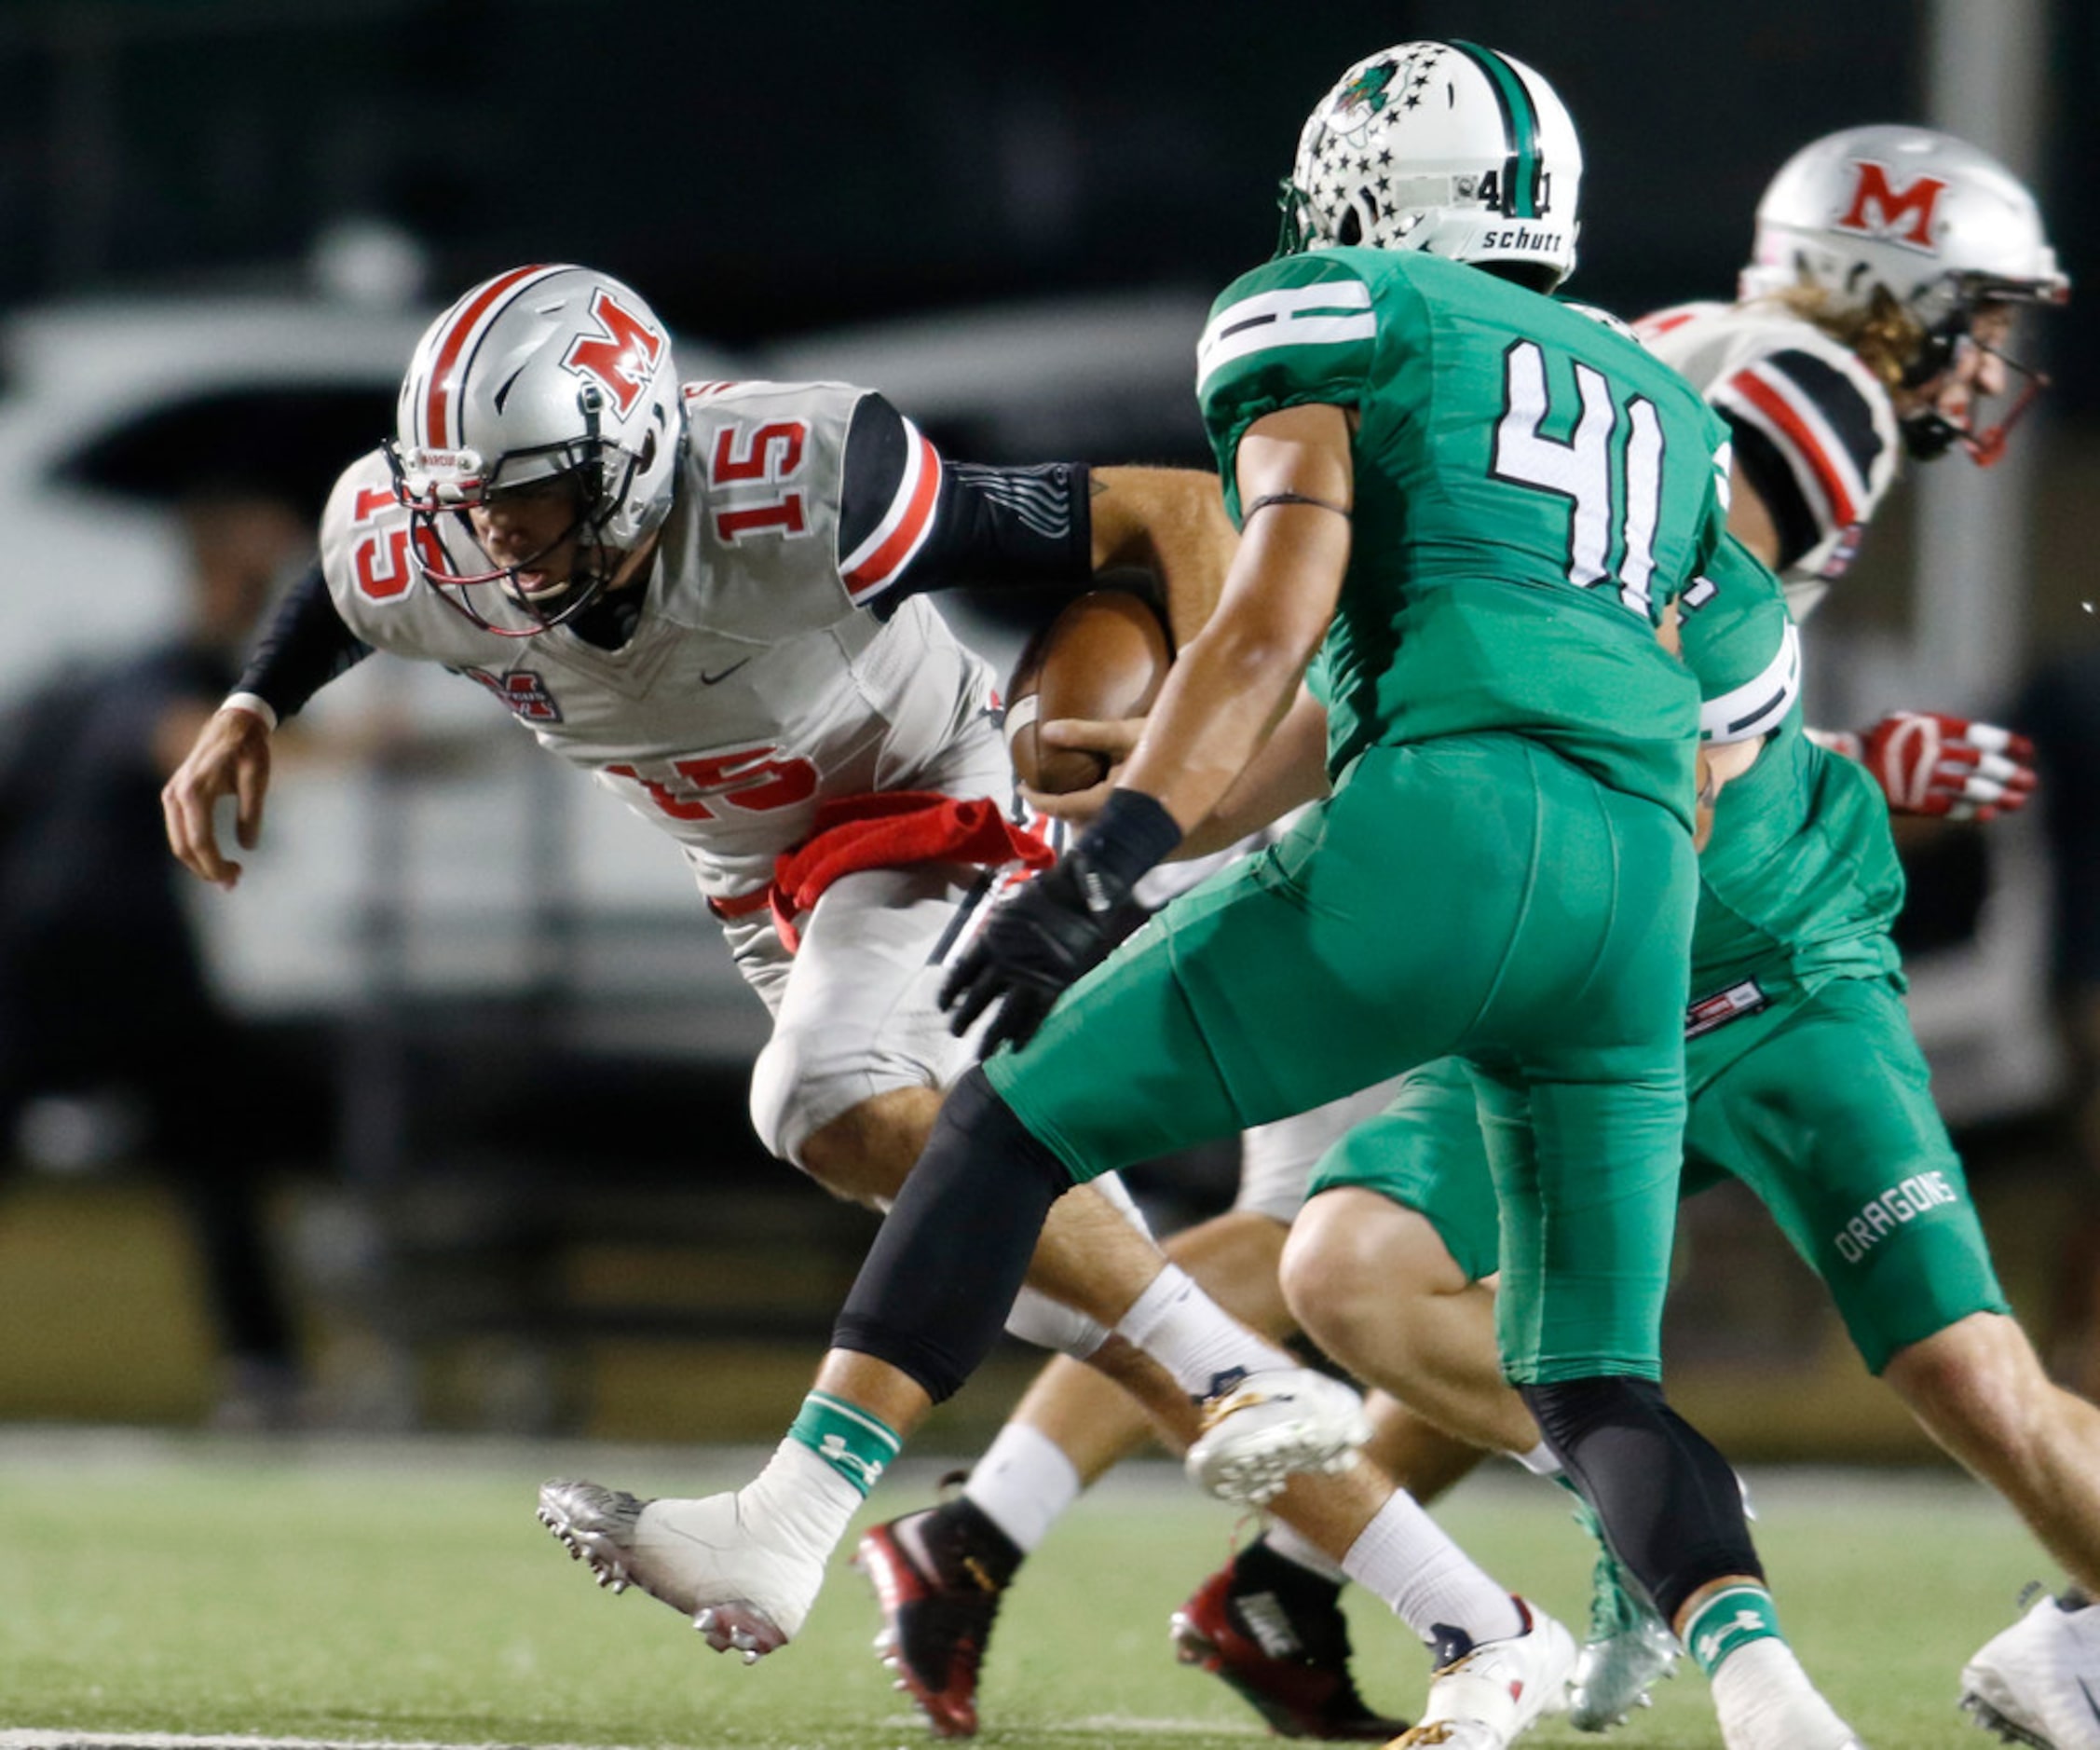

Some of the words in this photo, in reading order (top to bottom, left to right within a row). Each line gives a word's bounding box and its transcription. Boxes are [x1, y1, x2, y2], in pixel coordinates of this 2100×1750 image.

[1481, 226, 1561, 253] schutt
[1835, 160, 1950, 254] M
[559, 286, 665, 423] M
[708, 417, 814, 550] 15
[1487, 336, 1665, 628] 41
[348, 485, 458, 605] 15
[599, 745, 822, 821] 15
[1834, 1170, 1957, 1264] DRAGONS
